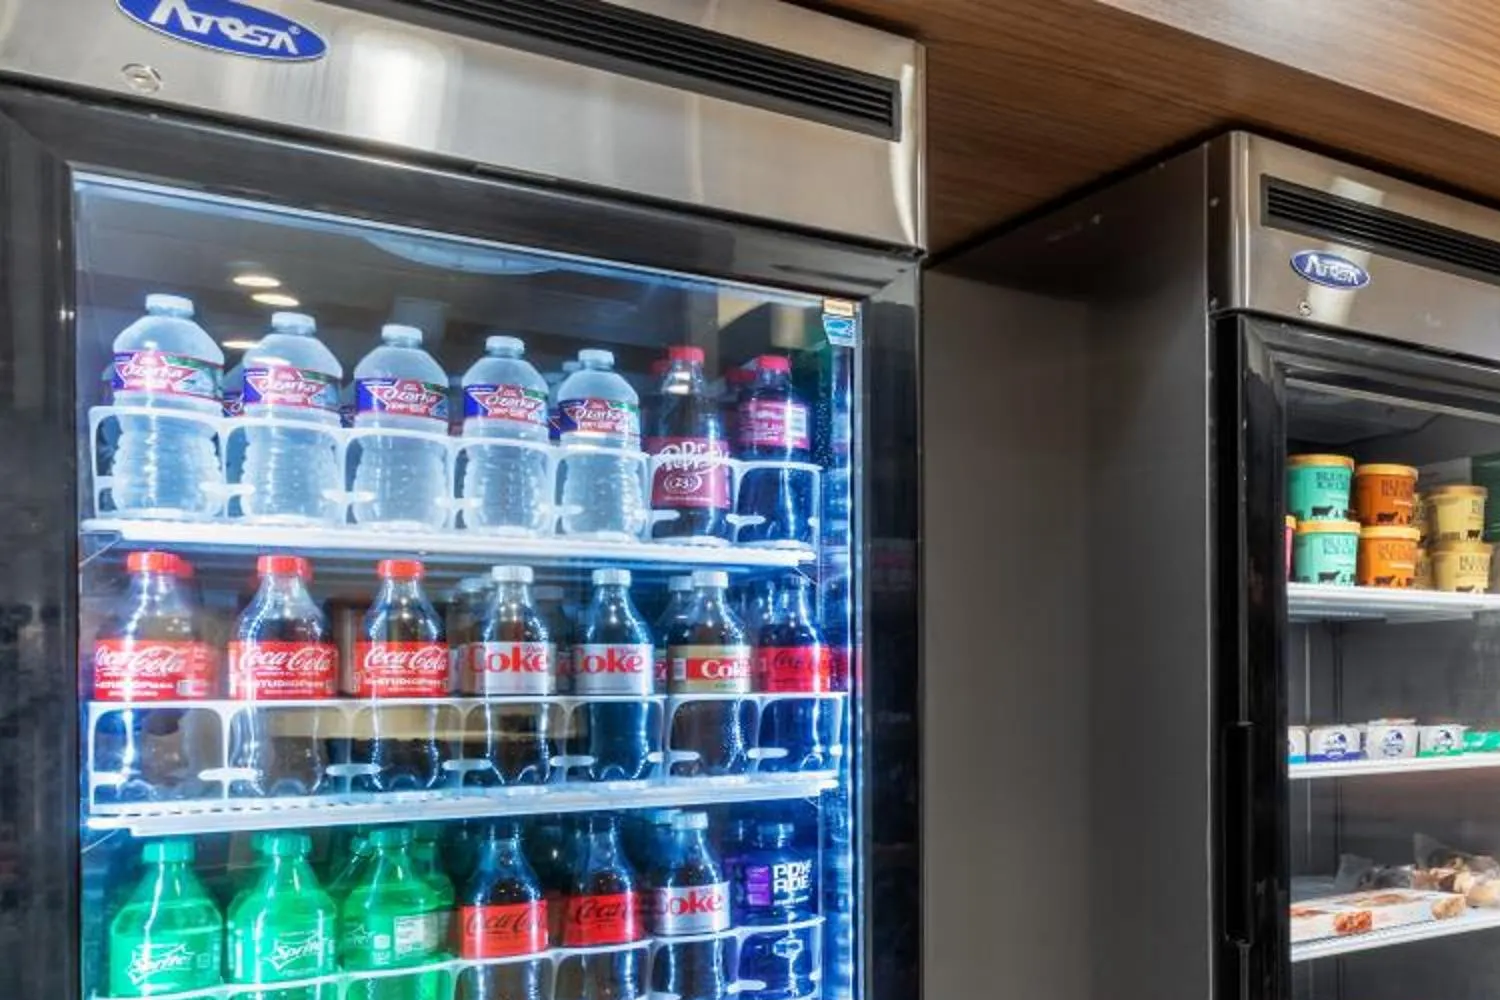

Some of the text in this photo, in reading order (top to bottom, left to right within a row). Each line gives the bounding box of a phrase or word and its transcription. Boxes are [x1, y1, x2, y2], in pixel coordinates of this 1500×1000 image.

[240, 647, 331, 672] Coca-Cola
[364, 646, 448, 671] Coca-Cola
[468, 643, 547, 673] Coke
